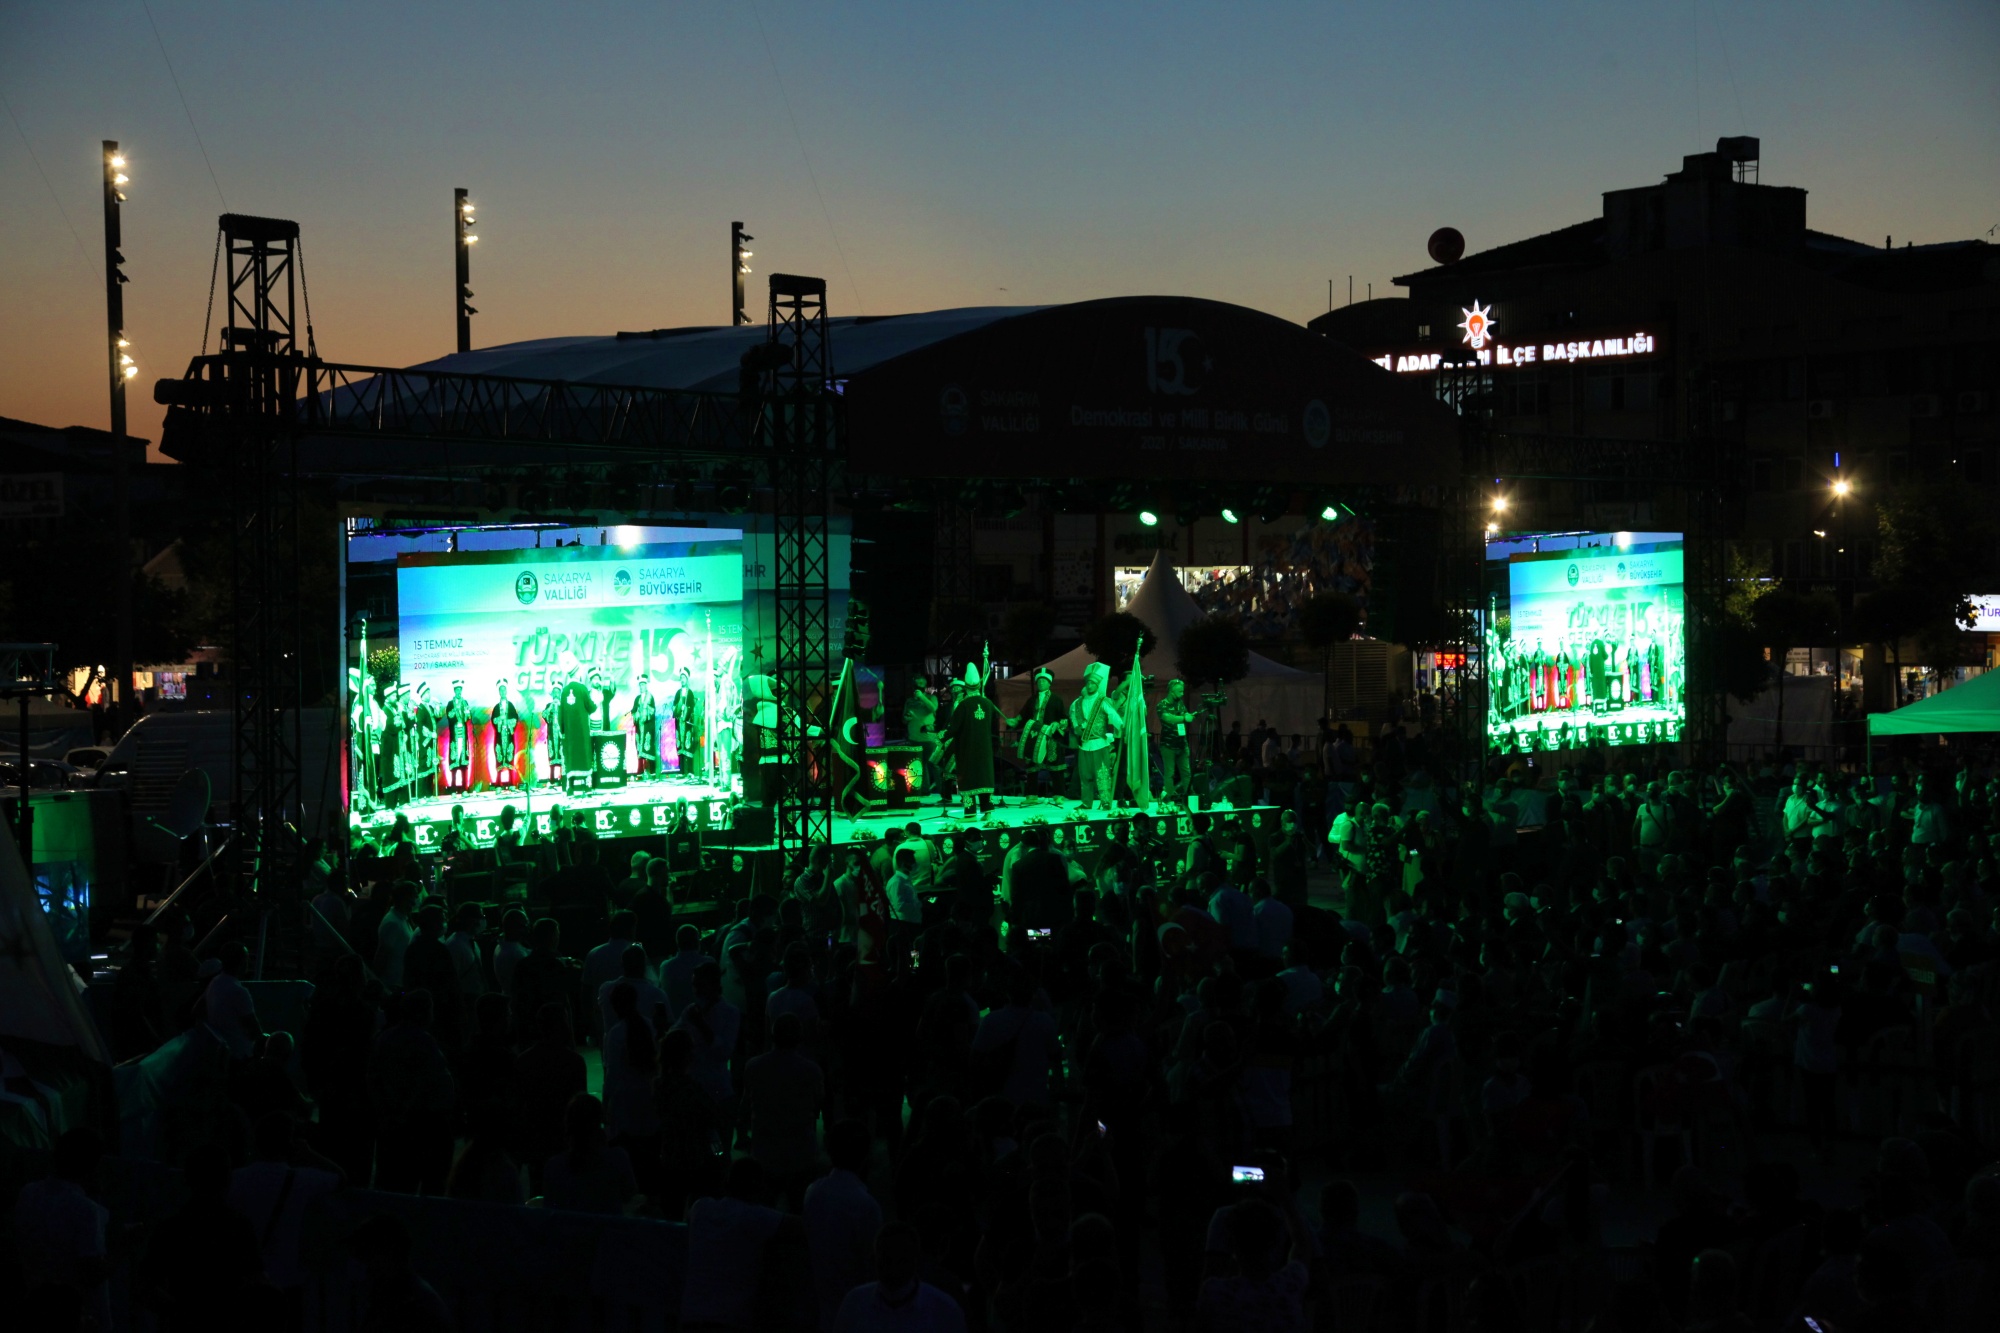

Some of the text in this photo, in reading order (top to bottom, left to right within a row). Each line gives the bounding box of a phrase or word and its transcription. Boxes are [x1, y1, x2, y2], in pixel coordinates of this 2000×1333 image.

[1497, 345, 1536, 367] İLÇE
[1543, 332, 1654, 362] BAŞKANLIĞI
[980, 389, 1040, 407] SAKARYA
[1071, 404, 1152, 428] Demokrasi
[1159, 413, 1175, 429] ve
[1214, 410, 1249, 432] Birlik
[1253, 412, 1288, 434] Günü
[544, 571, 592, 584] SAKARYA
[639, 566, 686, 580] SAKARYA
[544, 585, 587, 600] VALİLİĞİ
[639, 581, 702, 596] BÜYÜKŞEHİR
[414, 638, 463, 650] 15 TEMMUZ
[640, 628, 680, 682] 15
[434, 660, 464, 668] SAKARYA
